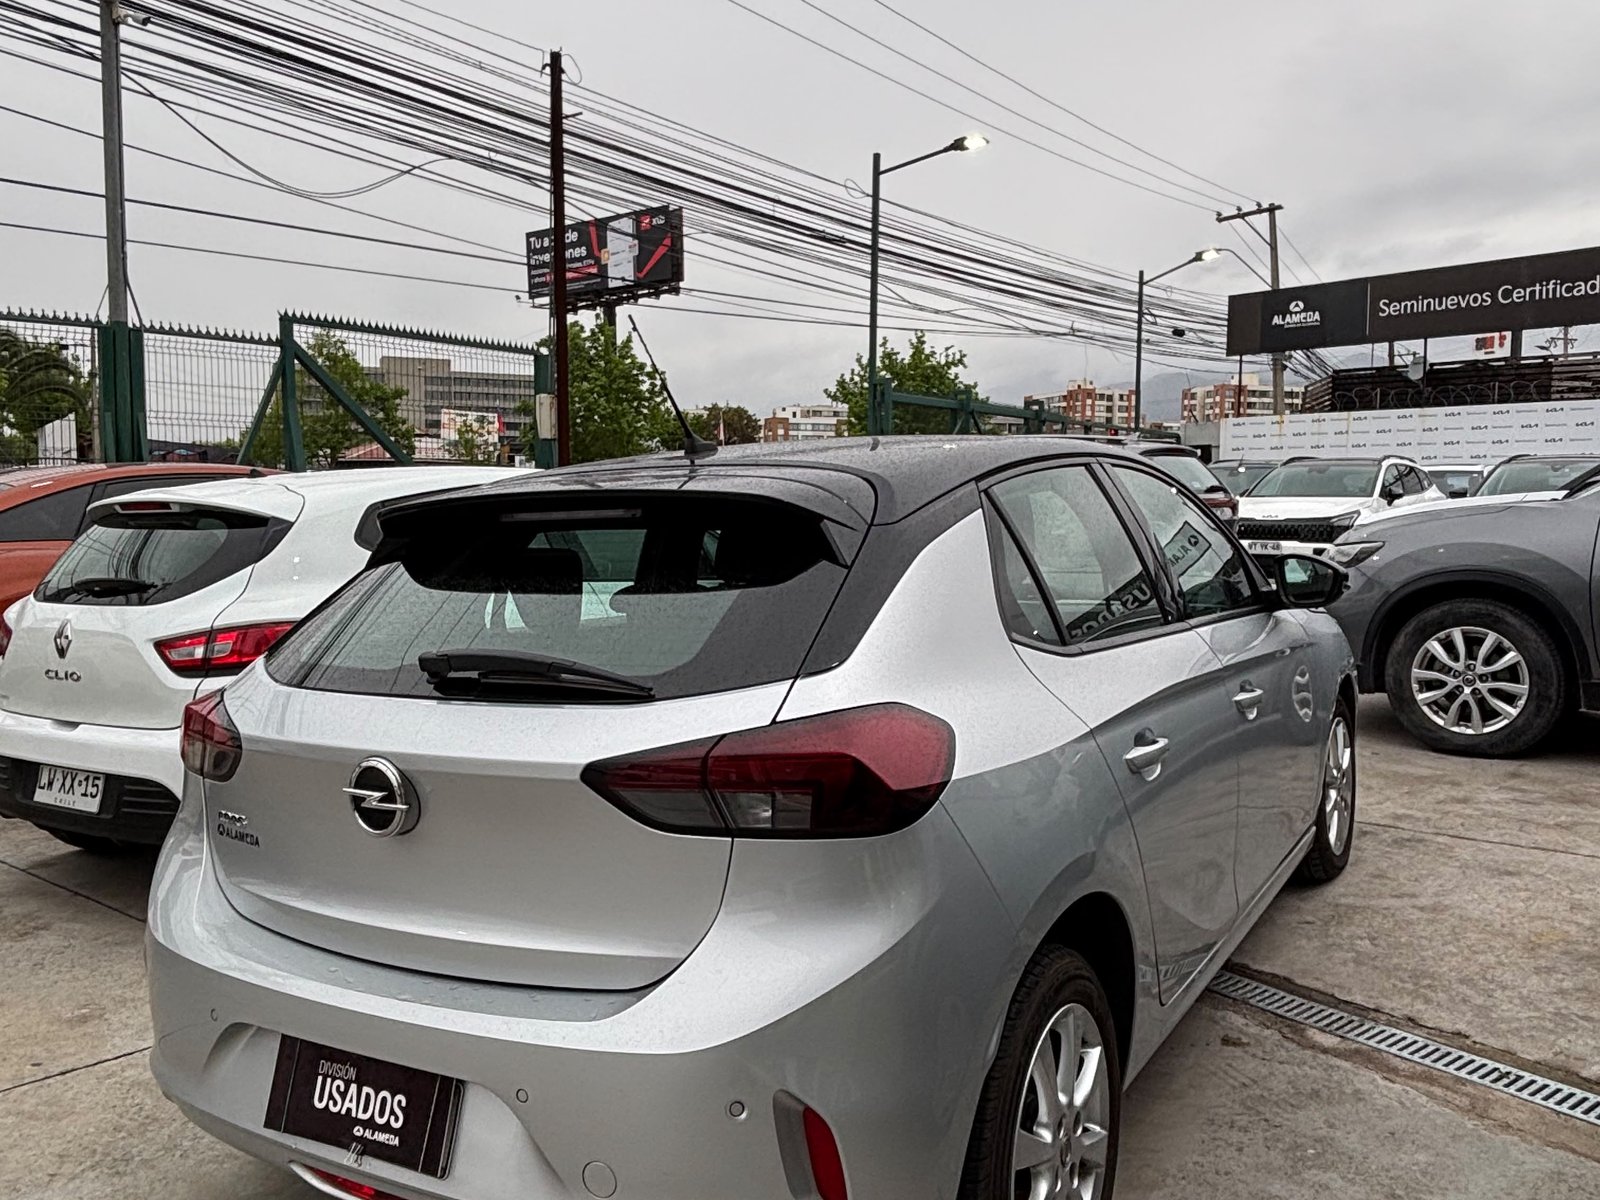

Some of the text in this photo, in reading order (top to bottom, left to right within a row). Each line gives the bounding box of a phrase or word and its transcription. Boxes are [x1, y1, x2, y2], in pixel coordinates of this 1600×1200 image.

[1379, 275, 1600, 316] Seminuevos Certificad
[1271, 311, 1320, 325] ALAMEDA
[44, 668, 82, 682] CLIO
[226, 827, 260, 848] ALAMEDA
[319, 1059, 357, 1081] DIVISIÓN
[313, 1075, 407, 1129] USADOS
[363, 1128, 400, 1147] ALAMEDA
